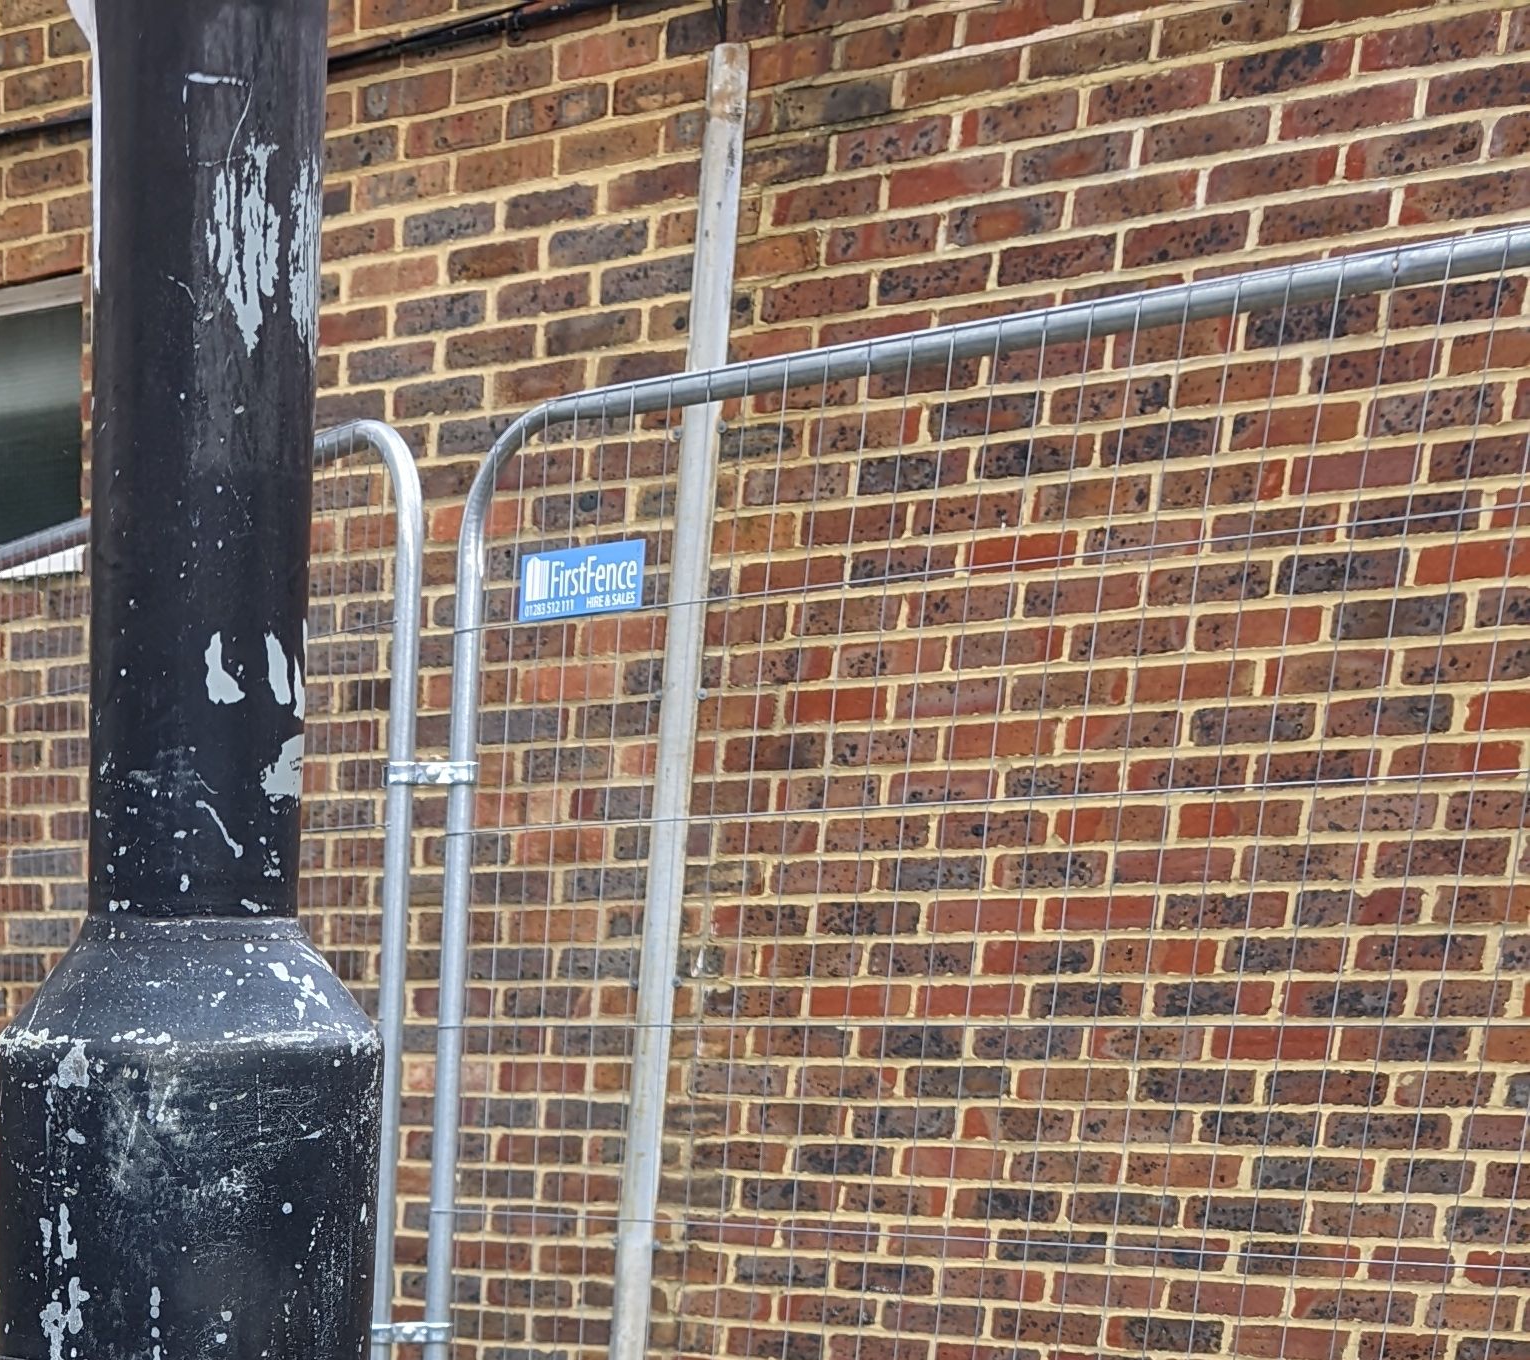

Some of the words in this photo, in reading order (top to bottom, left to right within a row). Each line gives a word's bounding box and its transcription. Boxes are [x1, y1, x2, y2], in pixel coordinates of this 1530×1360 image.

[551, 555, 637, 599] FirstFence
[586, 595, 603, 609] HIRE
[604, 595, 611, 607] &
[612, 591, 636, 606] SALES
